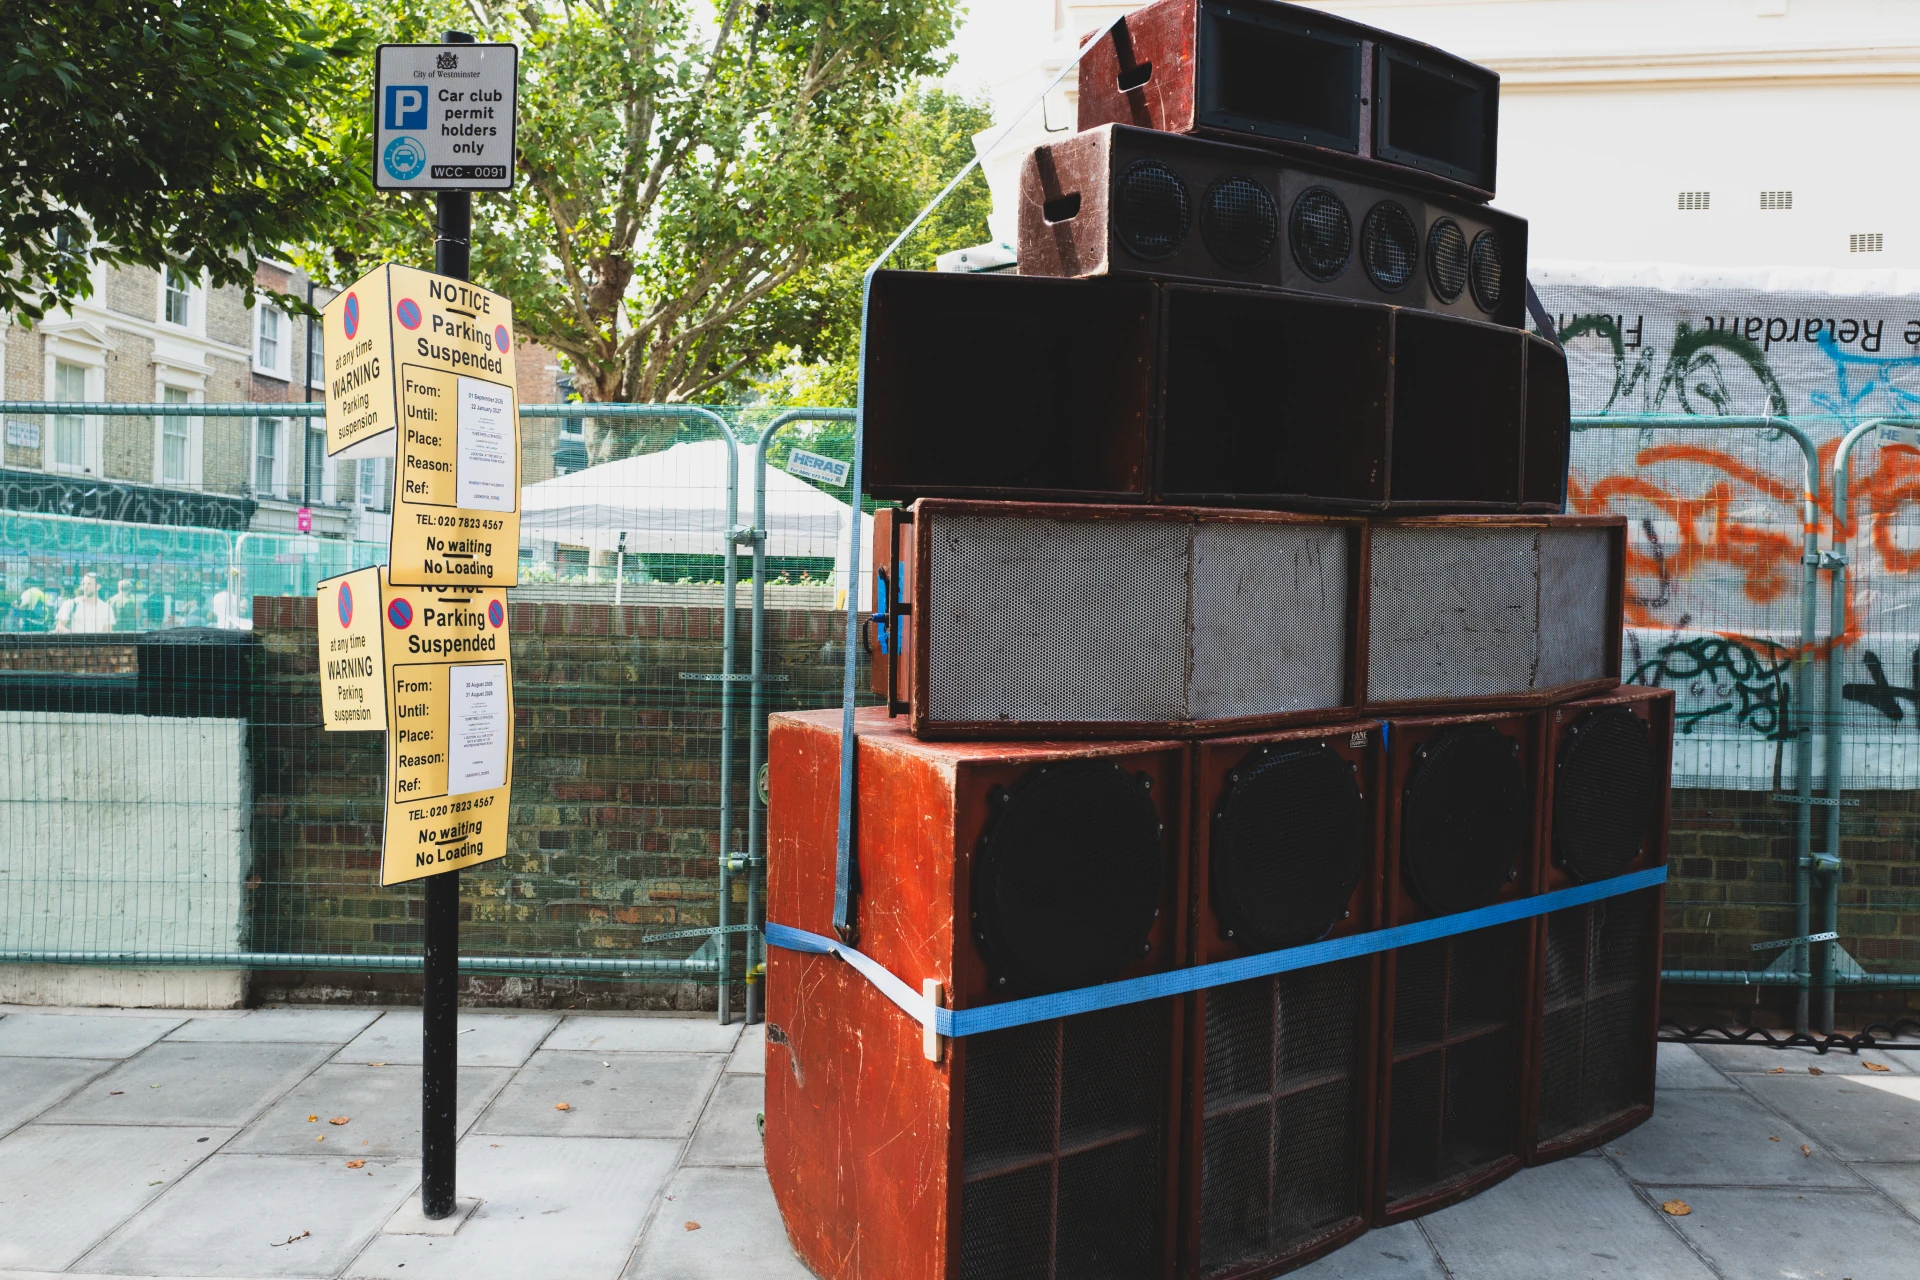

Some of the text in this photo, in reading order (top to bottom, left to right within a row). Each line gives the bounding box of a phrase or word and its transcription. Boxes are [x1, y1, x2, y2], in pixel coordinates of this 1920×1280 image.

[413, 70, 481, 80] City of Westminster
[438, 89, 502, 102] Car club
[395, 90, 422, 127] P
[445, 106, 494, 121] permit
[441, 124, 497, 136] holders
[453, 141, 484, 155] only
[434, 167, 463, 177] WCC
[474, 167, 504, 177] 0091
[429, 279, 490, 314] NOTICE
[432, 314, 492, 351] Parking
[1537, 314, 1643, 347] Flam
[335, 338, 373, 371] at any time
[417, 337, 503, 375] Suspended
[332, 357, 380, 401] WARNING
[406, 379, 441, 398] From:
[342, 392, 369, 417] Parking
[406, 404, 438, 422] Until:
[477, 404, 493, 414] January
[338, 410, 378, 440] suspension
[407, 429, 442, 447] Place:
[406, 454, 453, 473] Reason:
[793, 452, 845, 476] HERAS
[405, 480, 429, 495] Ref:
[416, 513, 504, 531] TEL: 020 7823 4567
[426, 536, 492, 556] No waiting
[424, 559, 493, 579] No Loading
[423, 608, 486, 631] Parking
[330, 633, 366, 653] at any time
[408, 633, 496, 657] Suspended
[327, 655, 373, 680] WARNING
[337, 685, 364, 703] Parking
[397, 679, 432, 693] From:
[334, 707, 371, 724] suspension
[398, 704, 429, 718] Until:
[399, 728, 434, 743] Place:
[399, 752, 445, 768] Reason:
[398, 778, 421, 793] Ref:
[408, 796, 495, 821] TEL: 020 7823 4567
[418, 820, 483, 844] No waiting
[415, 841, 483, 867] No Loading
